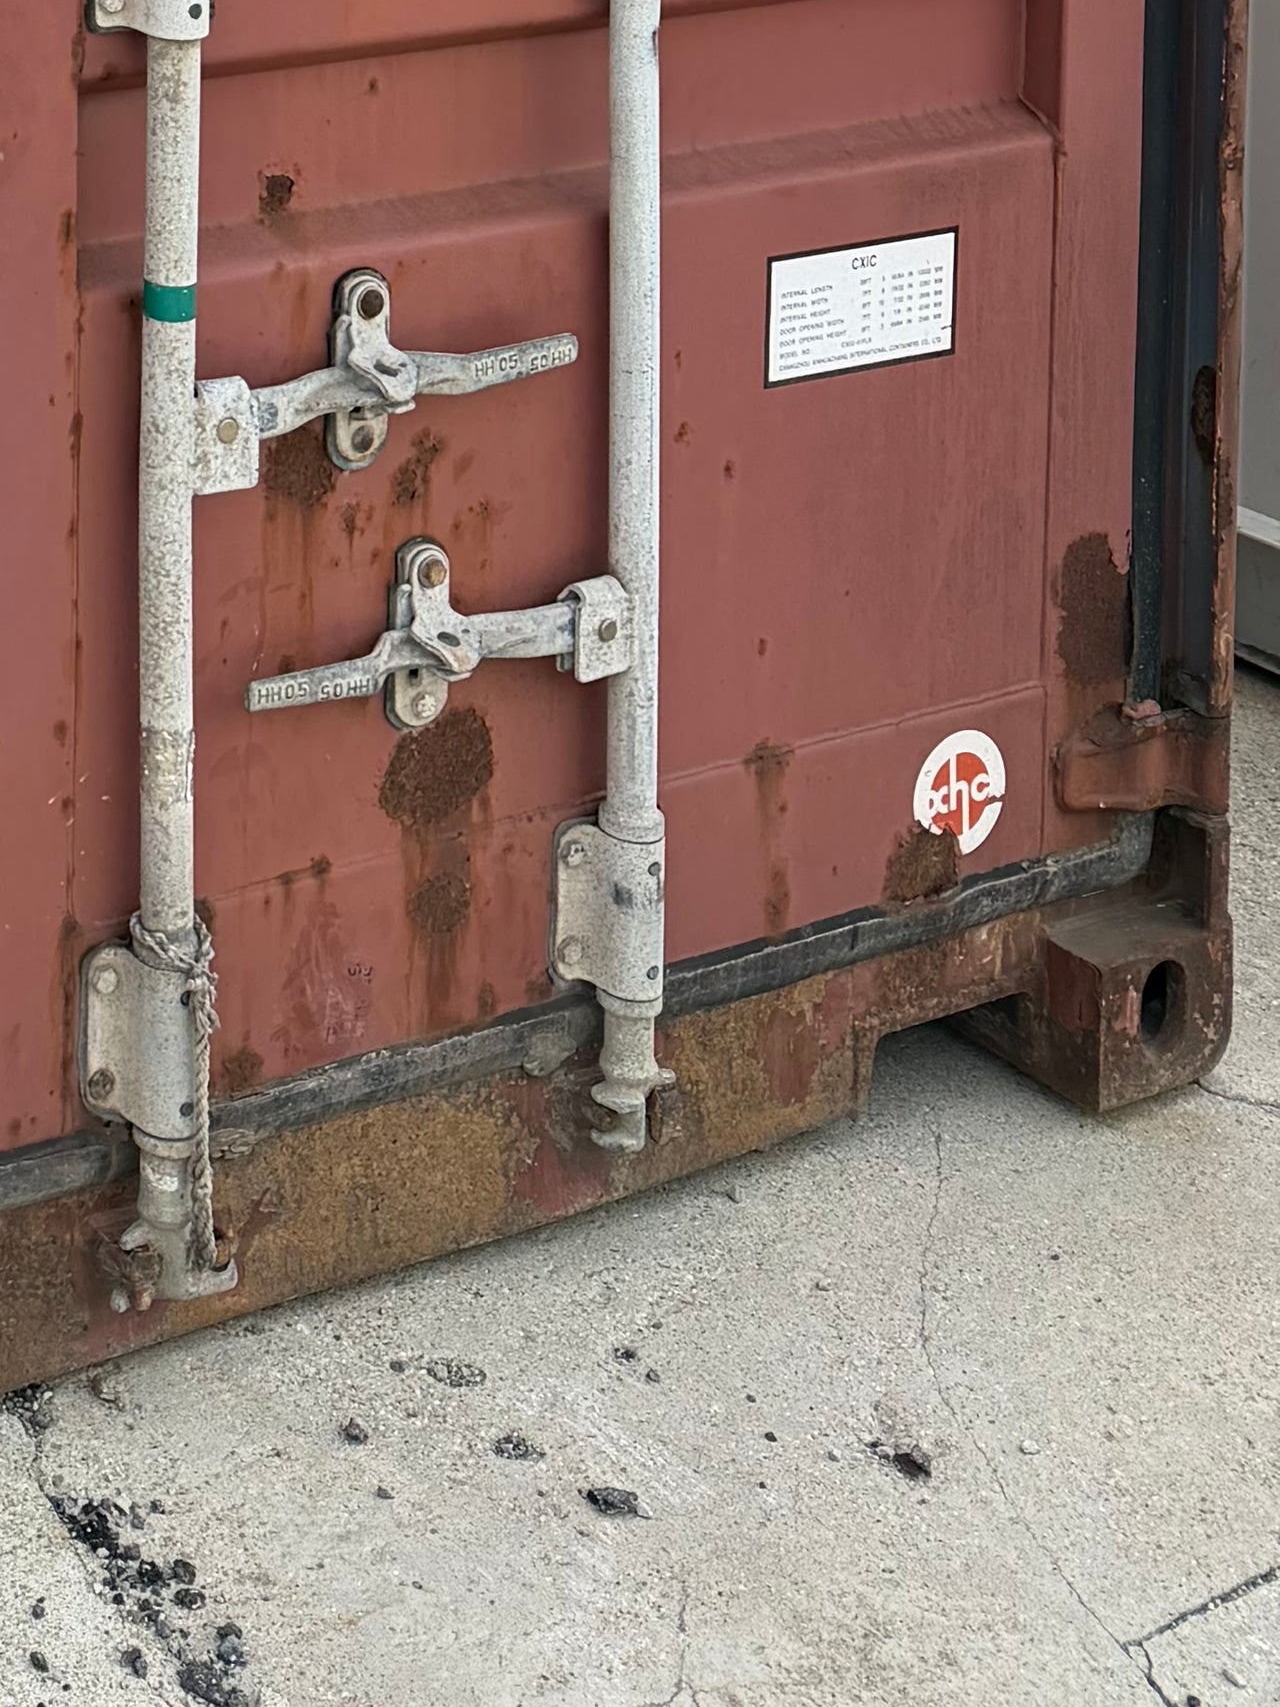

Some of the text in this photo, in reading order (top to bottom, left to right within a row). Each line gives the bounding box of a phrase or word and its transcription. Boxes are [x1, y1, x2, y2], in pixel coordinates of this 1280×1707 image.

[851, 253, 877, 270] CXIC
[475, 353, 518, 378] HH05
[257, 681, 308, 705] HH05
